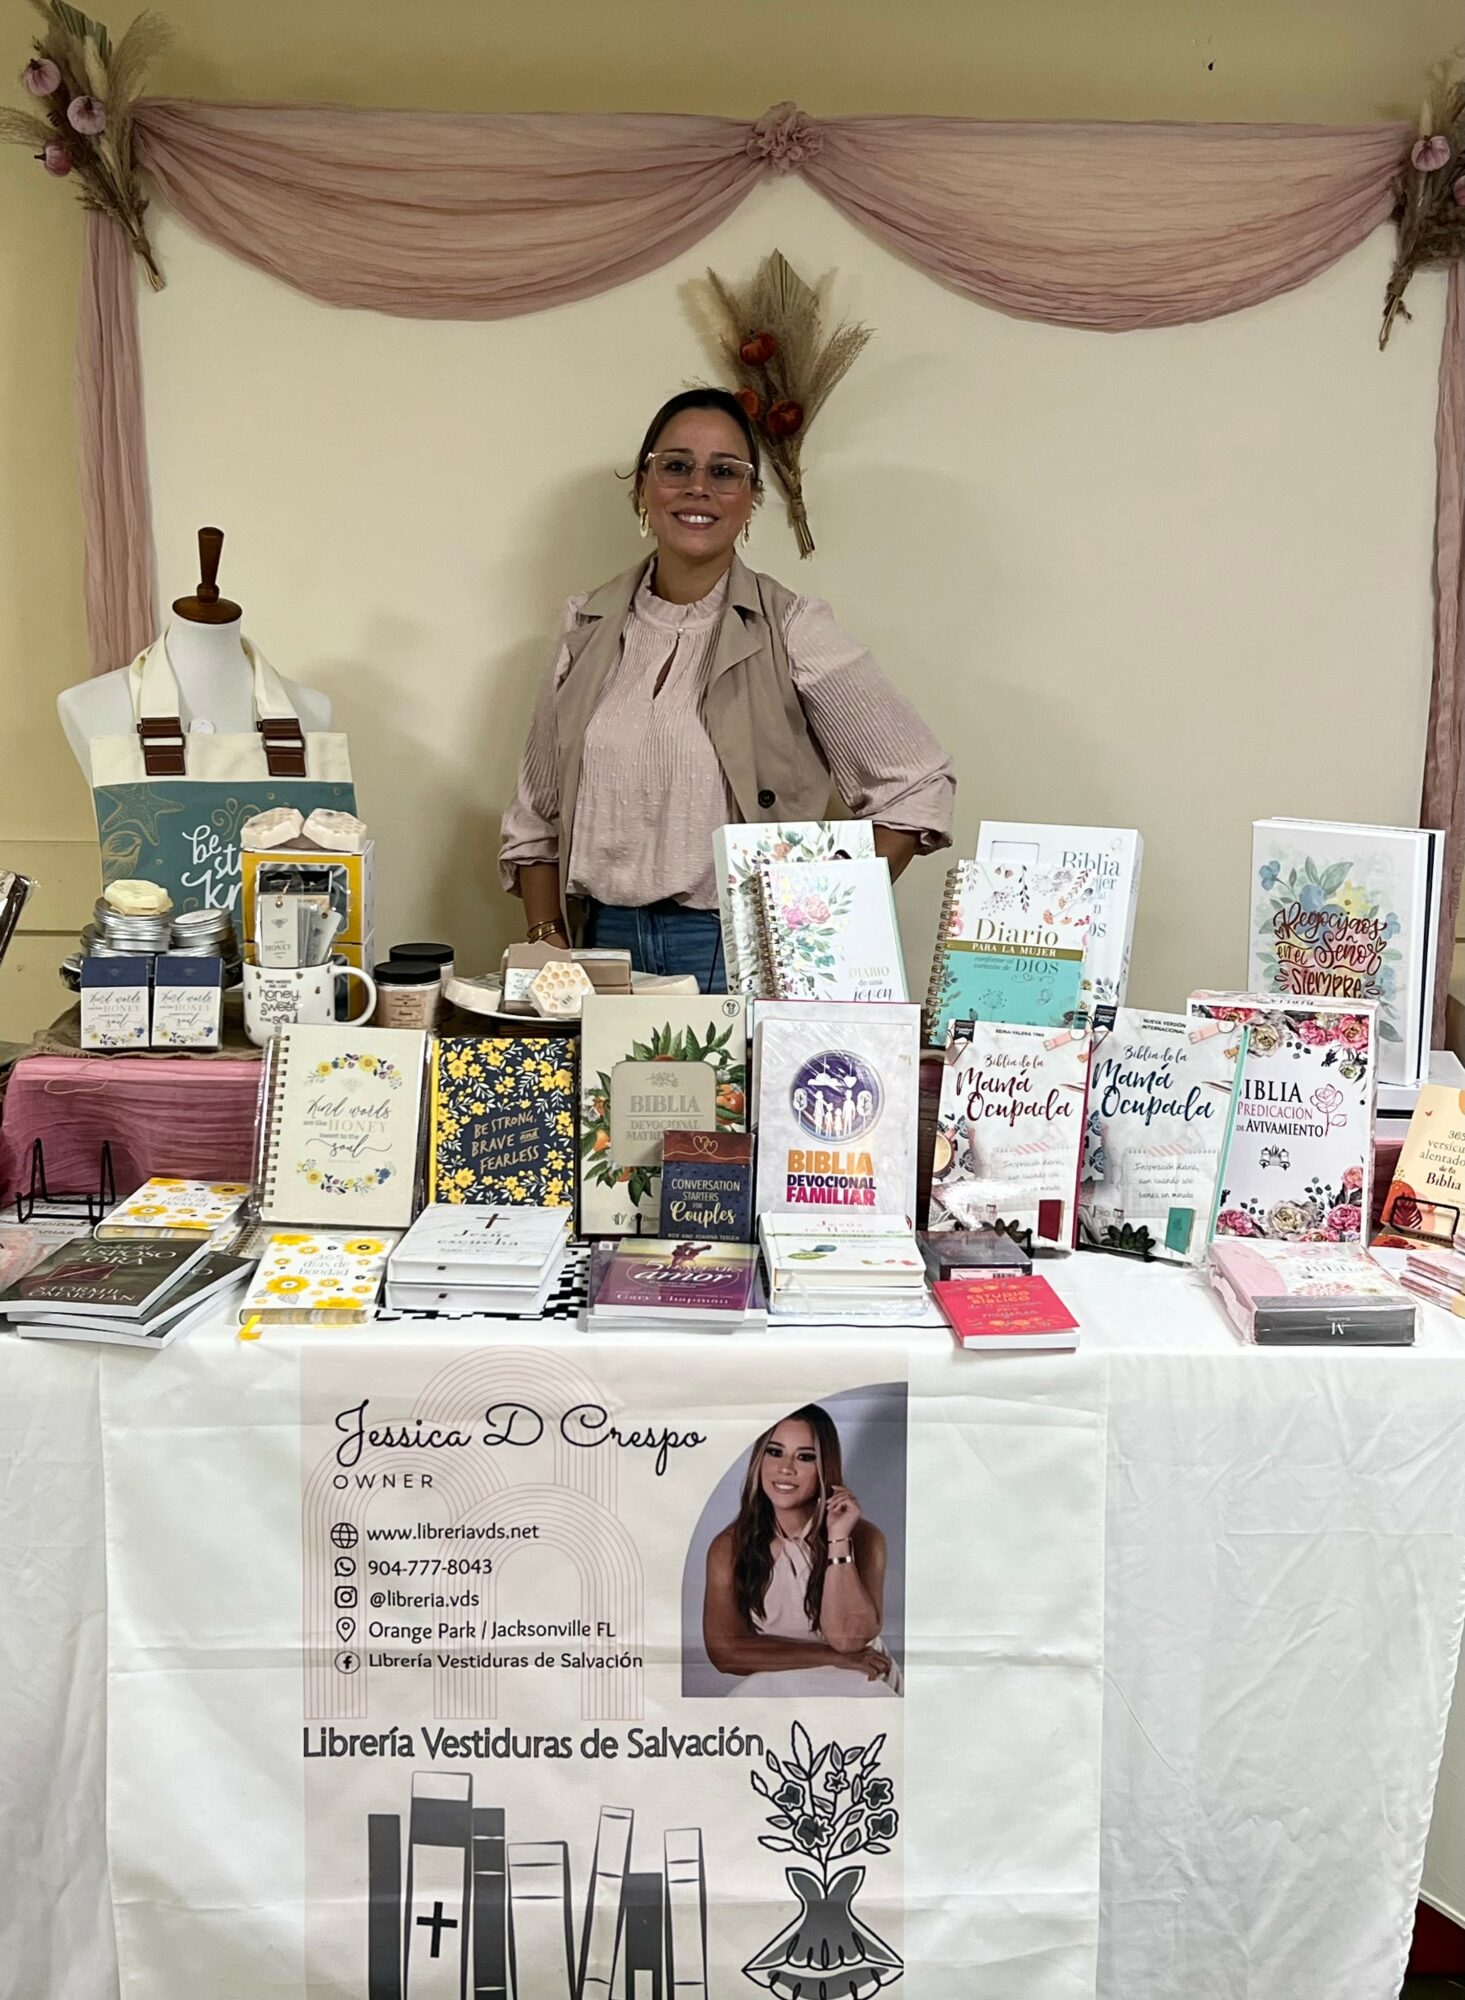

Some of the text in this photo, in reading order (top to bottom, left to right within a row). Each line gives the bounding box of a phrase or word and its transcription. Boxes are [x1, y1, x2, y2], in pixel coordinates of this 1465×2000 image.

[182, 825, 222, 865] be
[976, 918, 1060, 946] Diario
[1273, 902, 1387, 943] Regocijaos
[972, 943, 1057, 958] PARA LA MUJER
[1277, 945, 1291, 959] en
[1314, 931, 1382, 976] Señor
[849, 967, 890, 978] DIARIO
[1015, 958, 1060, 975] DIOS
[1141, 1024, 1185, 1034] INTERNACIONAL
[984, 1053, 1018, 1068] Biblia
[1032, 1055, 1045, 1069] la
[1123, 1045, 1159, 1061] Biblia
[1175, 1048, 1188, 1063] la
[956, 1067, 1033, 1098] Mamá
[1092, 1058, 1174, 1094] Mamá
[1239, 1079, 1303, 1103] IBLIA
[349, 1099, 392, 1119] words
[630, 1095, 701, 1113] BIBLIA
[966, 1088, 1073, 1127] Ocupada
[1101, 1086, 1215, 1126] Ocupada
[328, 1119, 386, 1133] HONEY
[474, 1122, 489, 1139] BE
[630, 1119, 701, 1131] DEVOCIONAL
[1245, 1119, 1324, 1137] AVIVAMIENTO
[471, 1133, 516, 1157] BRAVE
[626, 1130, 663, 1141] MATRI
[480, 1145, 540, 1175] FEARLESS
[788, 1149, 875, 1176] BIBLIA
[671, 1178, 741, 1192] CONVERSATION
[787, 1174, 876, 1190] DEVOCIONAL
[1426, 1171, 1462, 1190] Biblia
[682, 1191, 719, 1201] STARTERS
[786, 1187, 876, 1206] FAMILIAR
[670, 1200, 736, 1229] Couples
[82, 1249, 177, 1259] ESPOSO
[85, 1256, 143, 1265] ORA
[634, 1270, 732, 1283] amor
[335, 1399, 707, 1477] Jessica D Crespo
[333, 1473, 434, 1490] OWNER
[367, 1522, 540, 1541] www.libreriavds.net
[368, 1558, 493, 1577] 904-777-8043
[369, 1590, 480, 1608] @libreria.vds
[369, 1621, 432, 1644] Orange
[438, 1621, 476, 1639] Park
[490, 1619, 591, 1639] Jacksonville
[597, 1622, 616, 1637] FL
[369, 1650, 643, 1669] Librería Vestiduras de Salvación
[303, 1725, 764, 1760] Librería Vestiduras de Salvación
